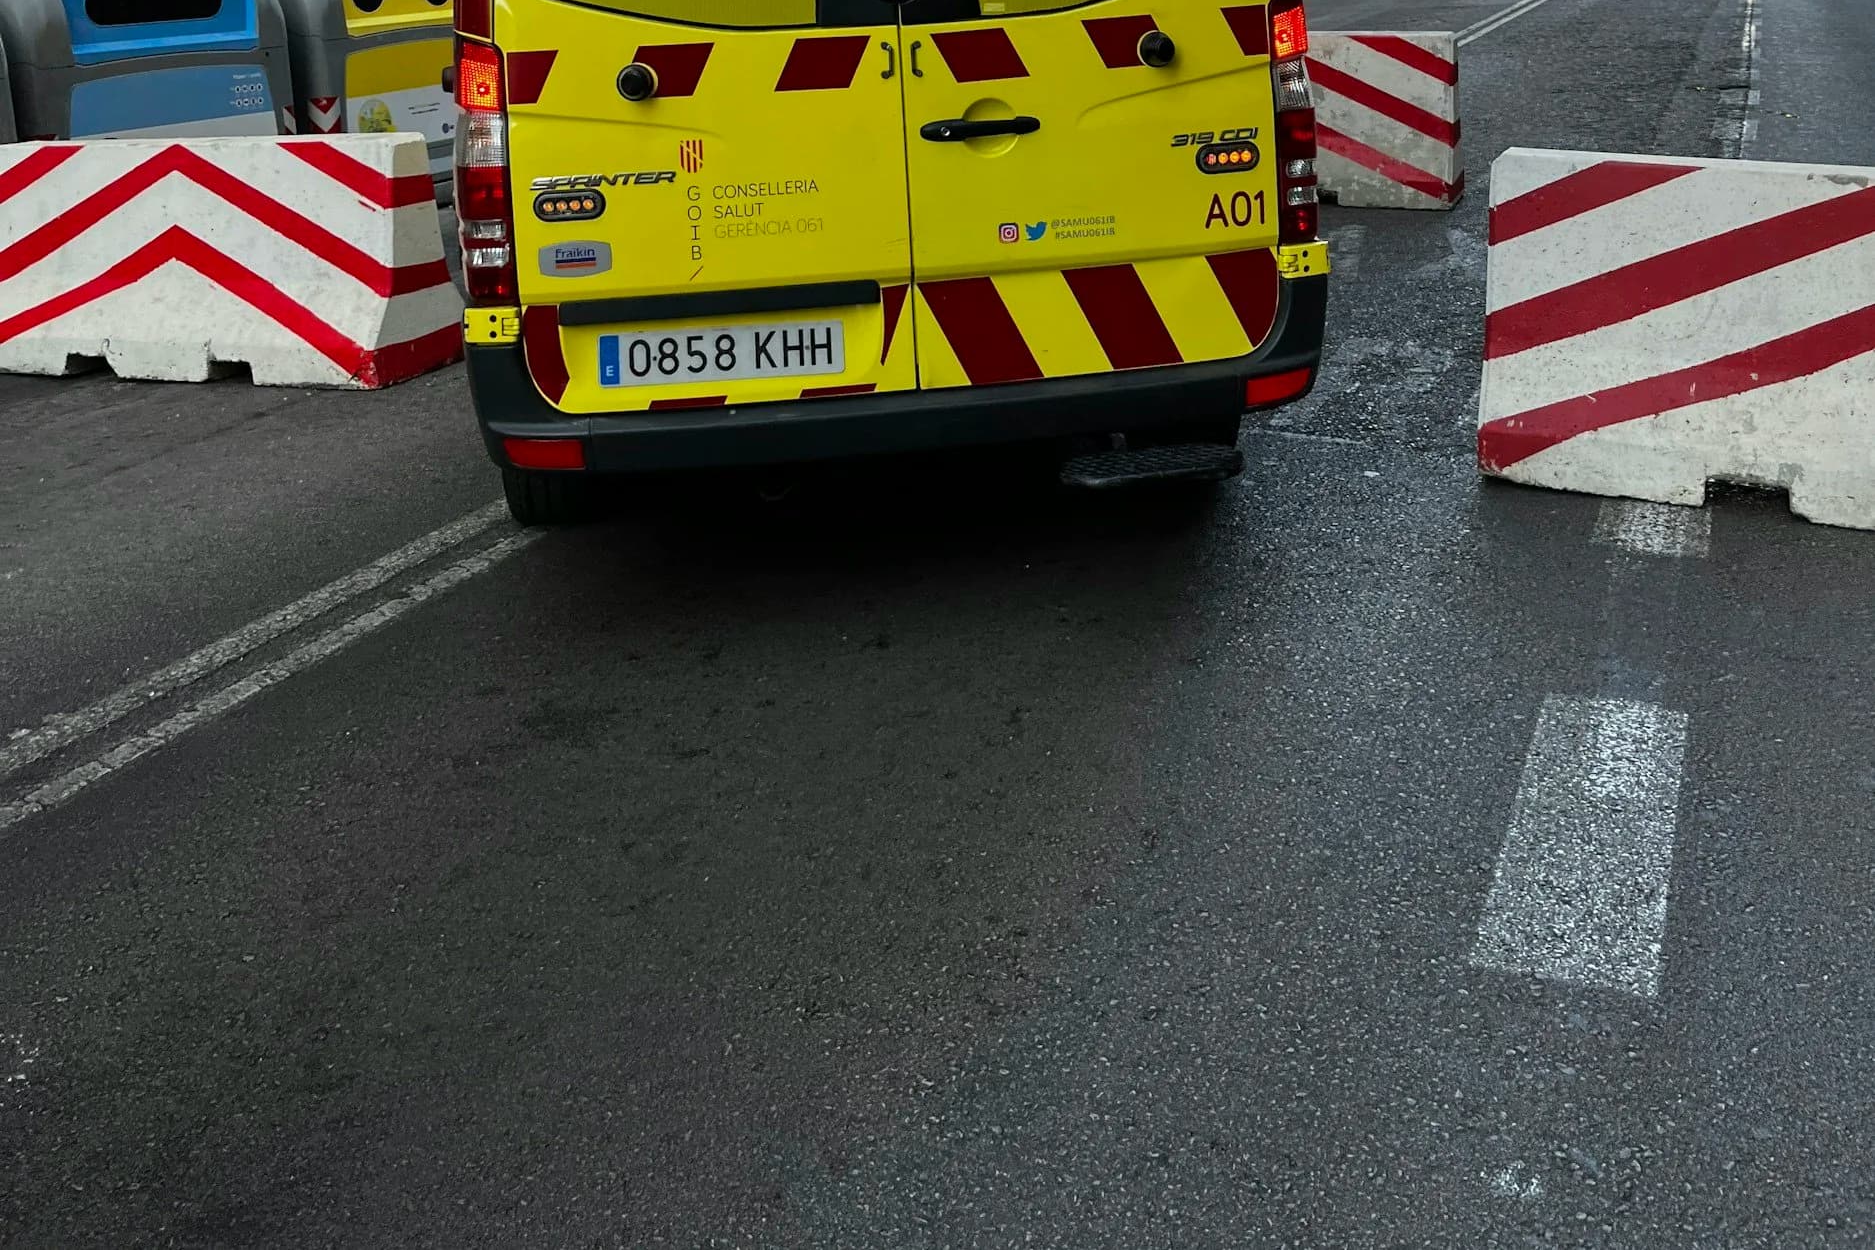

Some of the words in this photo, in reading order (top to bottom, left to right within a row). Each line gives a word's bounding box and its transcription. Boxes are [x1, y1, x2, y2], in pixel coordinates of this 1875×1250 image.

[1171, 132, 1215, 147] 319
[1219, 127, 1259, 142] CDI
[529, 171, 677, 191] SPRINTER
[712, 179, 820, 200] CONSELLERIA
[714, 202, 765, 219] SALUT
[1205, 190, 1265, 229] A01
[796, 217, 825, 234] 061
[629, 334, 737, 377] 0858
[754, 327, 833, 369] KHH
[606, 365, 614, 377] E
